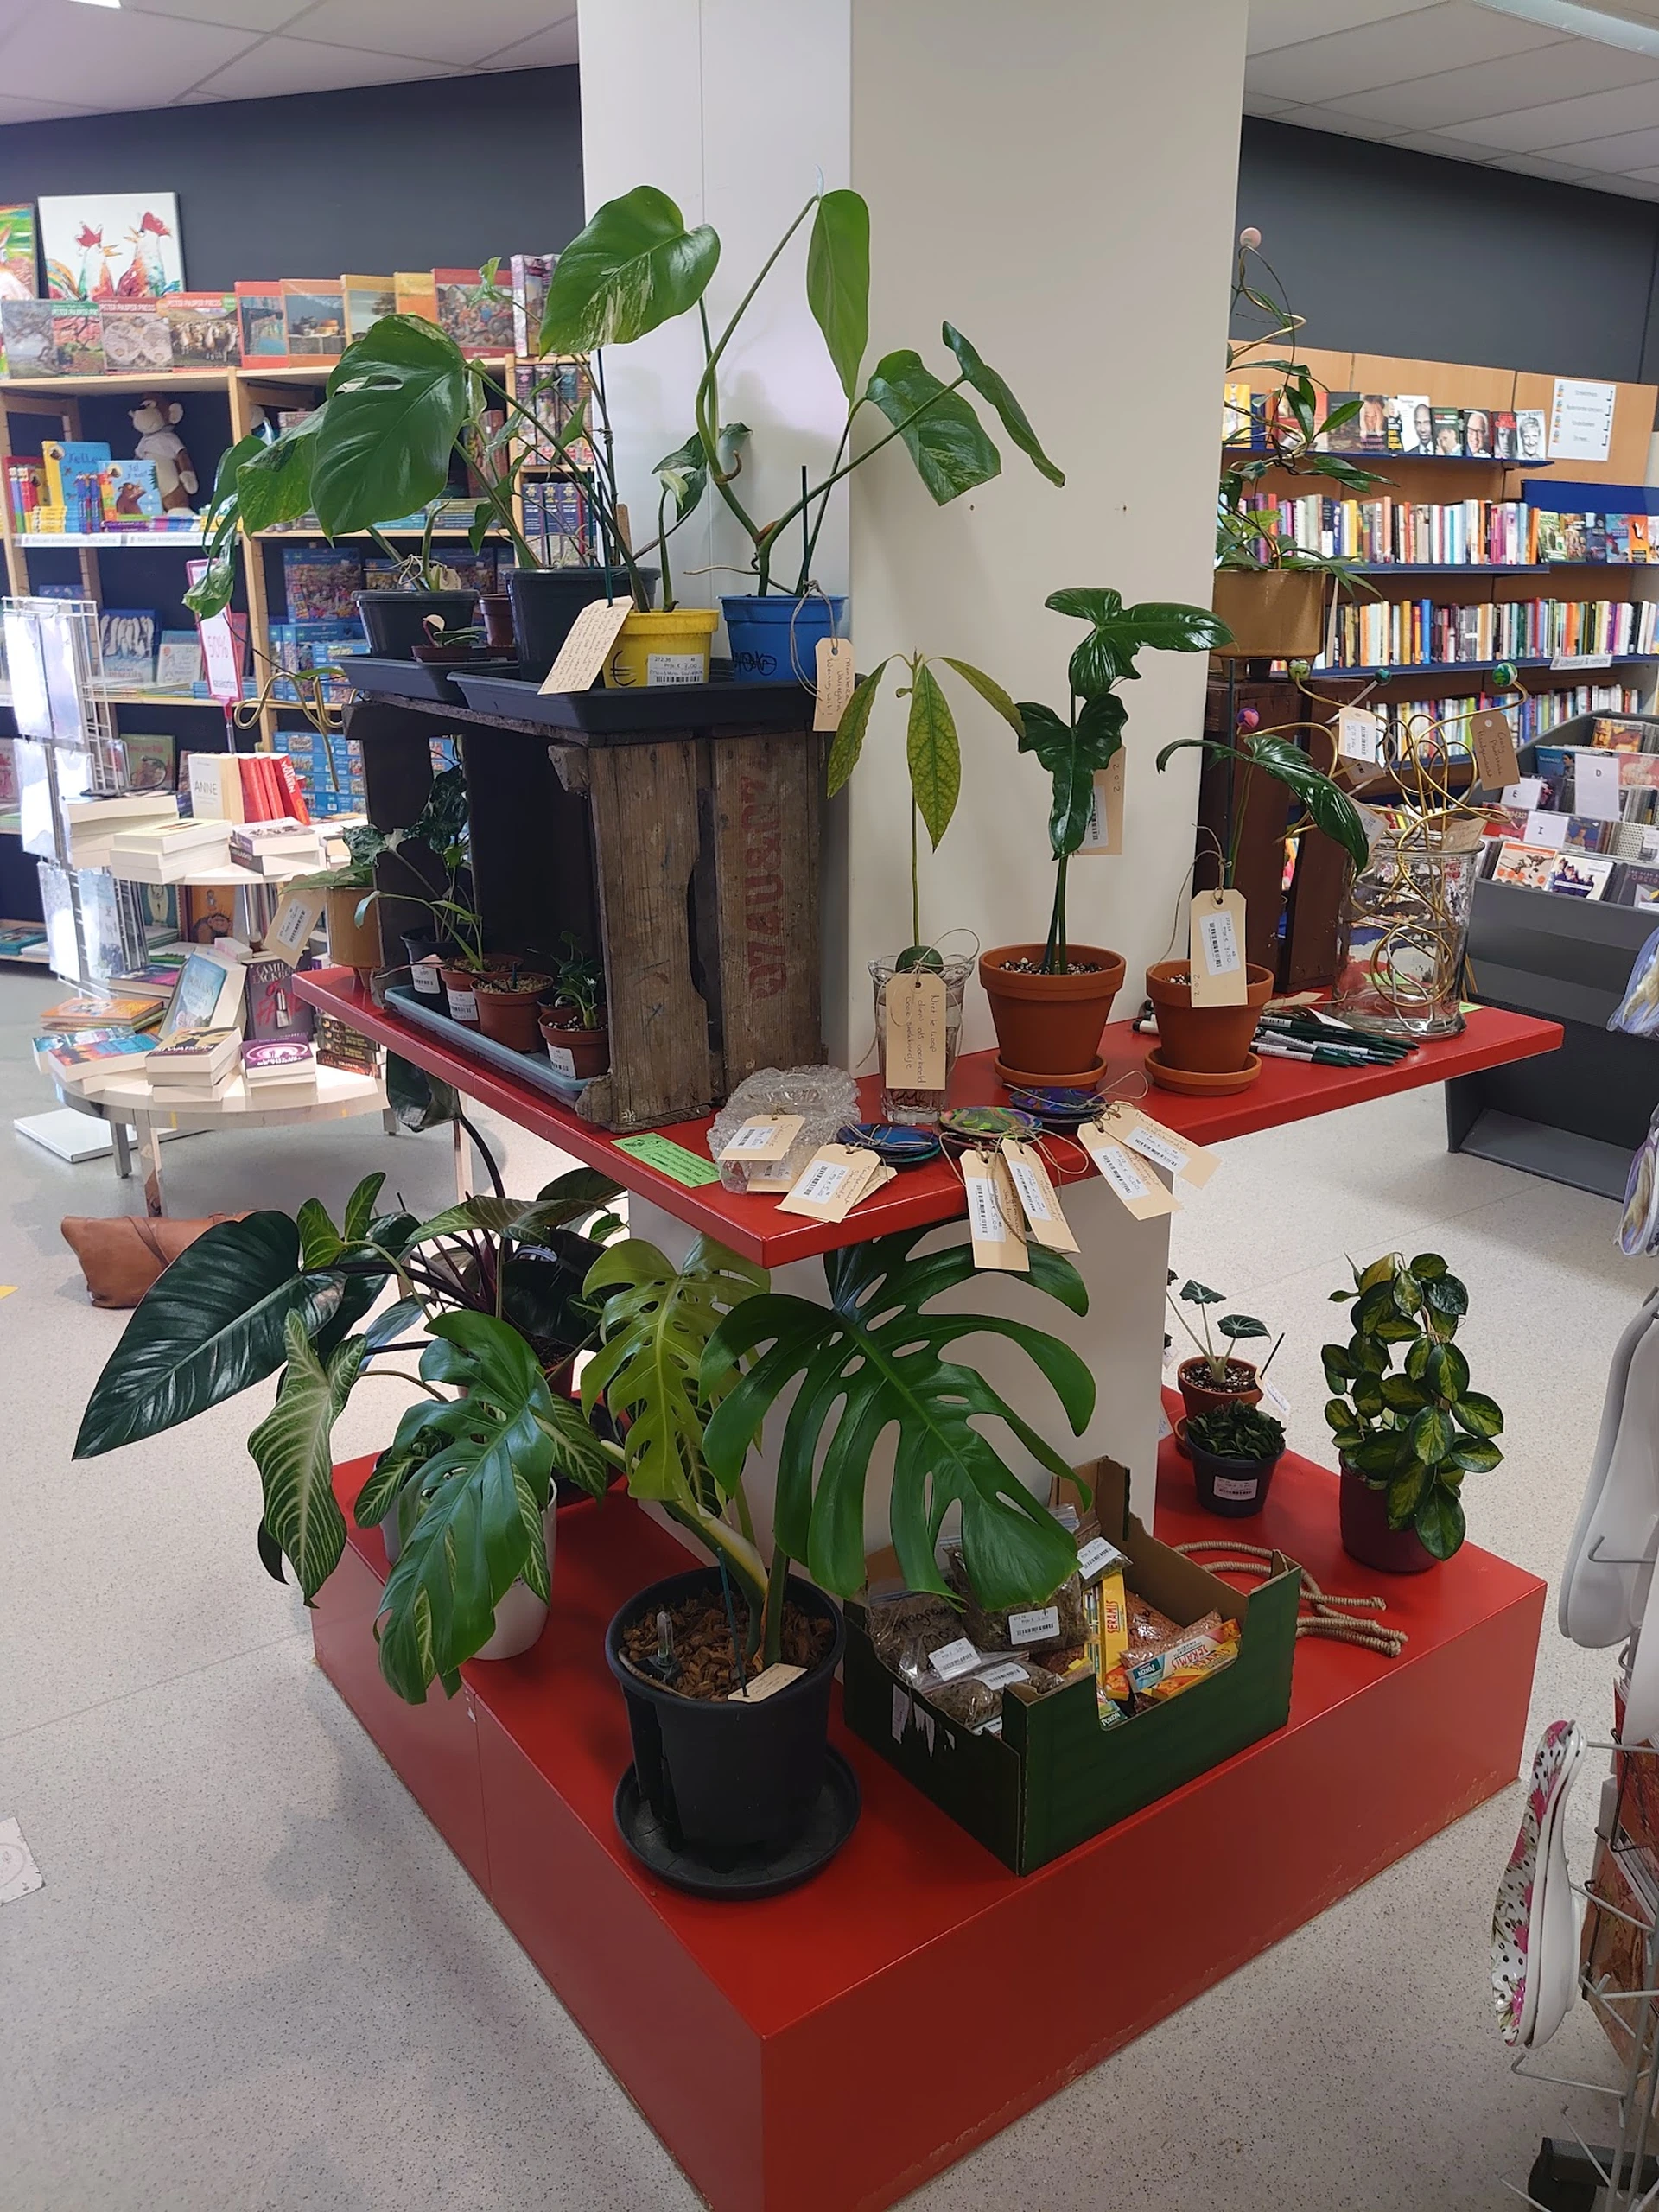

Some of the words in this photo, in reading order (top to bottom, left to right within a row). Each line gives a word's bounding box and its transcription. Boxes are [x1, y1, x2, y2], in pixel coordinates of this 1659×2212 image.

[280, 760, 296, 794] VUUREN
[194, 780, 218, 795] ANNE
[930, 995, 939, 1013] Niet
[1106, 1600, 1119, 1635] SERAMIS
[1171, 1644, 1210, 1672] SERAMIS
[1138, 1662, 1156, 1675] POKON
[1102, 1713, 1121, 1726] POKON
